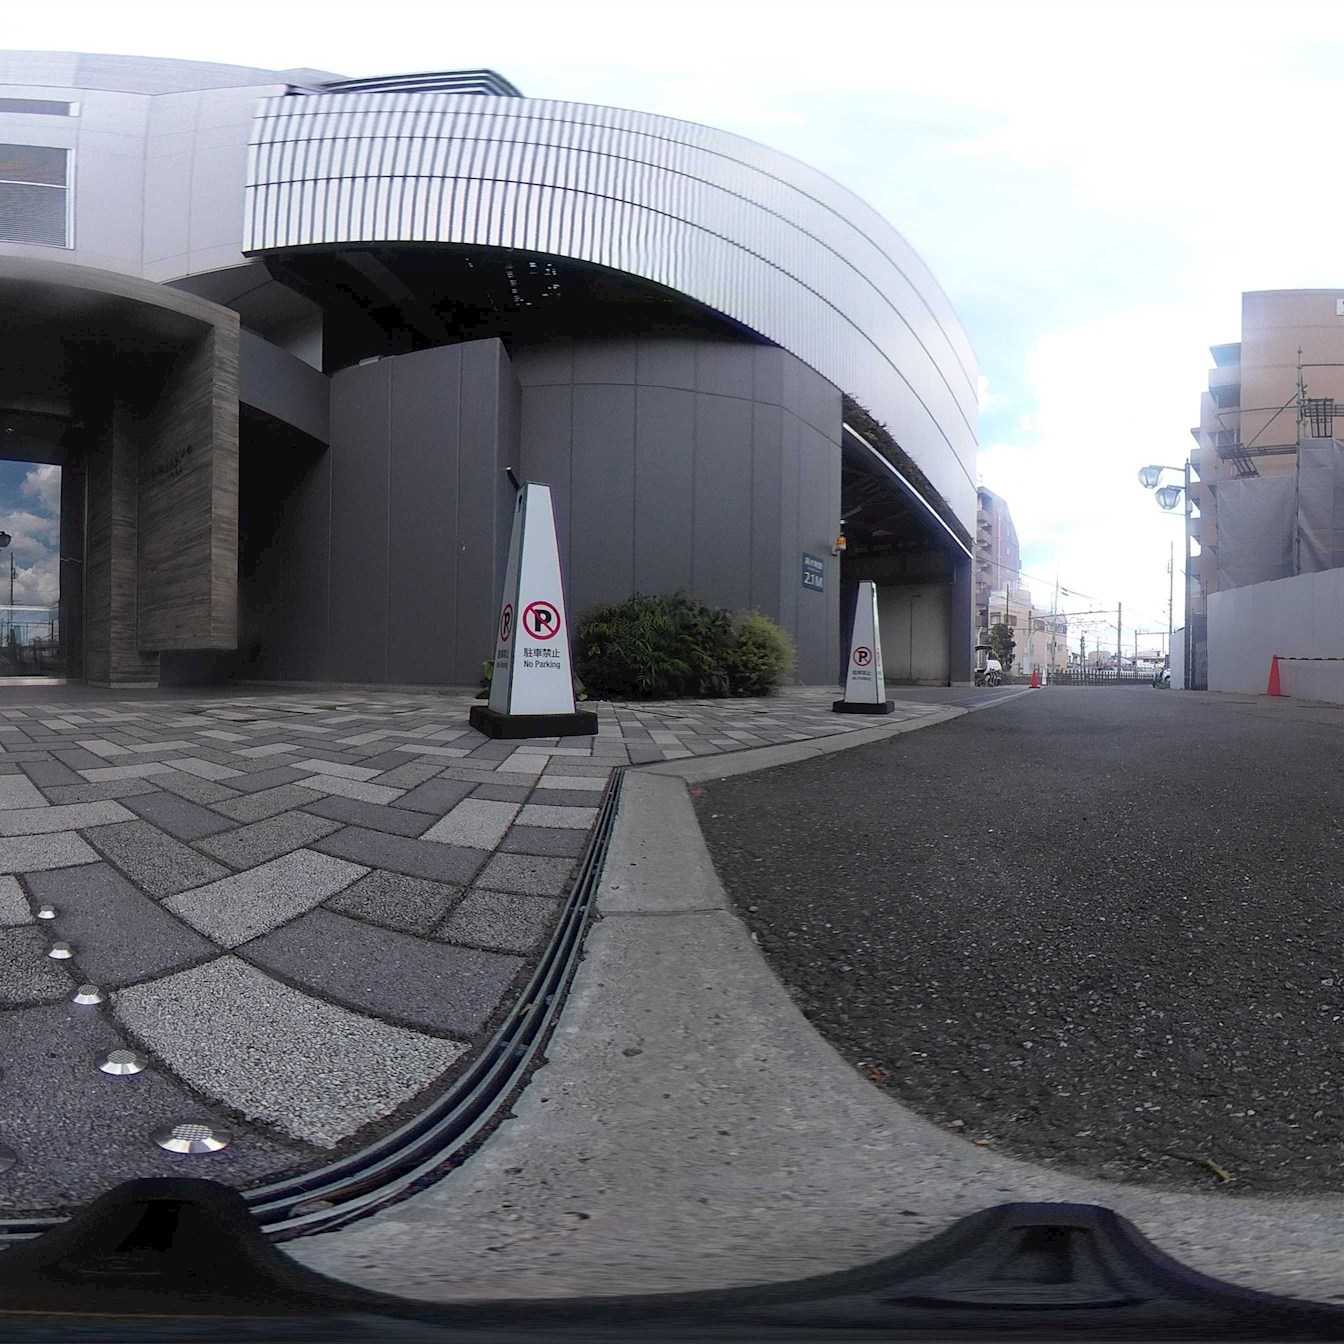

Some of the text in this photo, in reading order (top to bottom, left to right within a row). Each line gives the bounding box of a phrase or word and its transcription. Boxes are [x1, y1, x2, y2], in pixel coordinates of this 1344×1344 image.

[523, 647, 561, 659] 駐車禁止
[523, 660, 561, 670] No Parking
